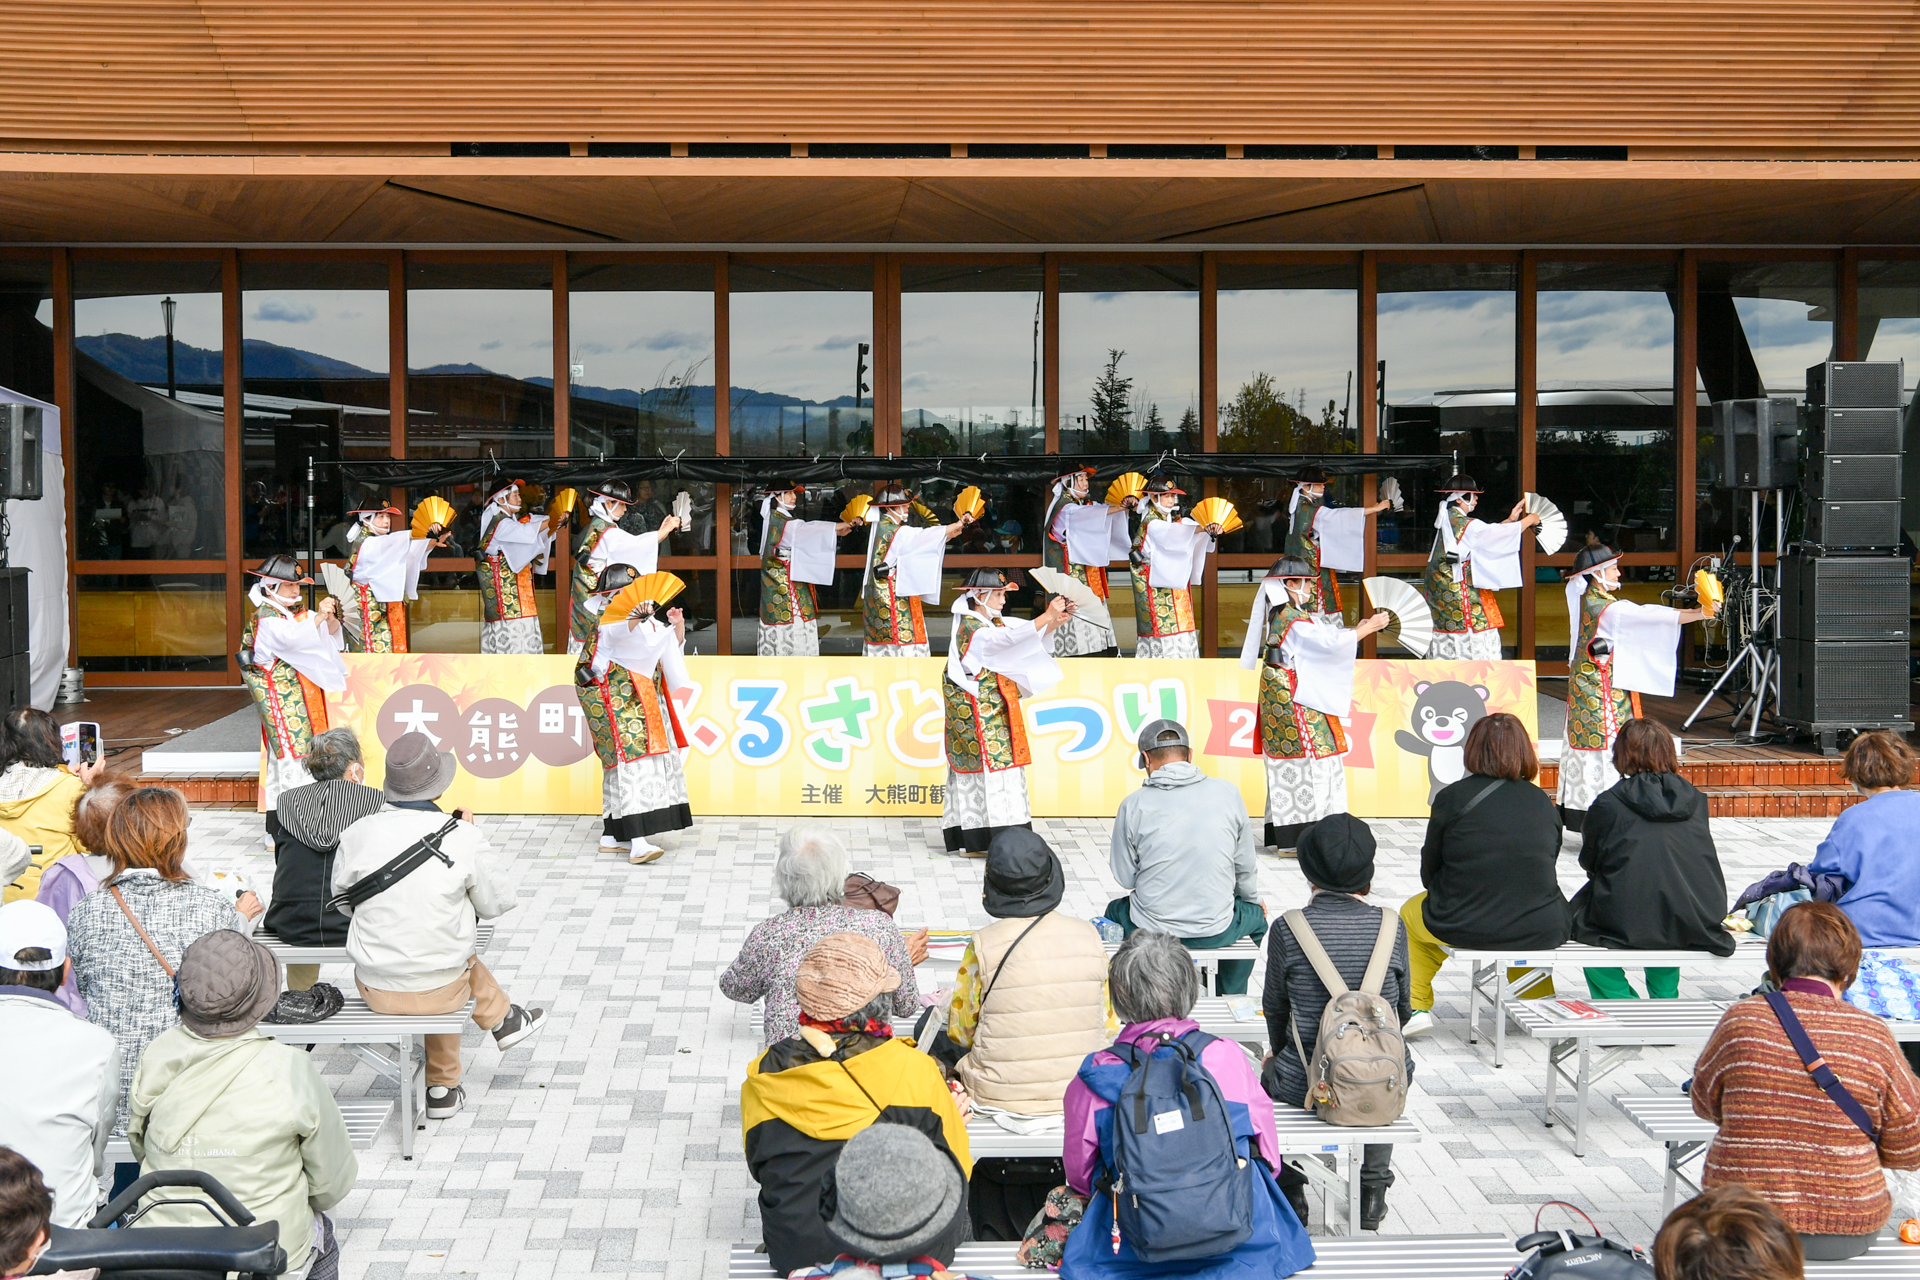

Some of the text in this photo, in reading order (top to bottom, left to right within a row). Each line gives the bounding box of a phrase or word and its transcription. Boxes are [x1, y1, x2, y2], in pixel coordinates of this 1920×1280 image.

[393, 698, 587, 763] 大熊町
[801, 783, 843, 805] 主催
